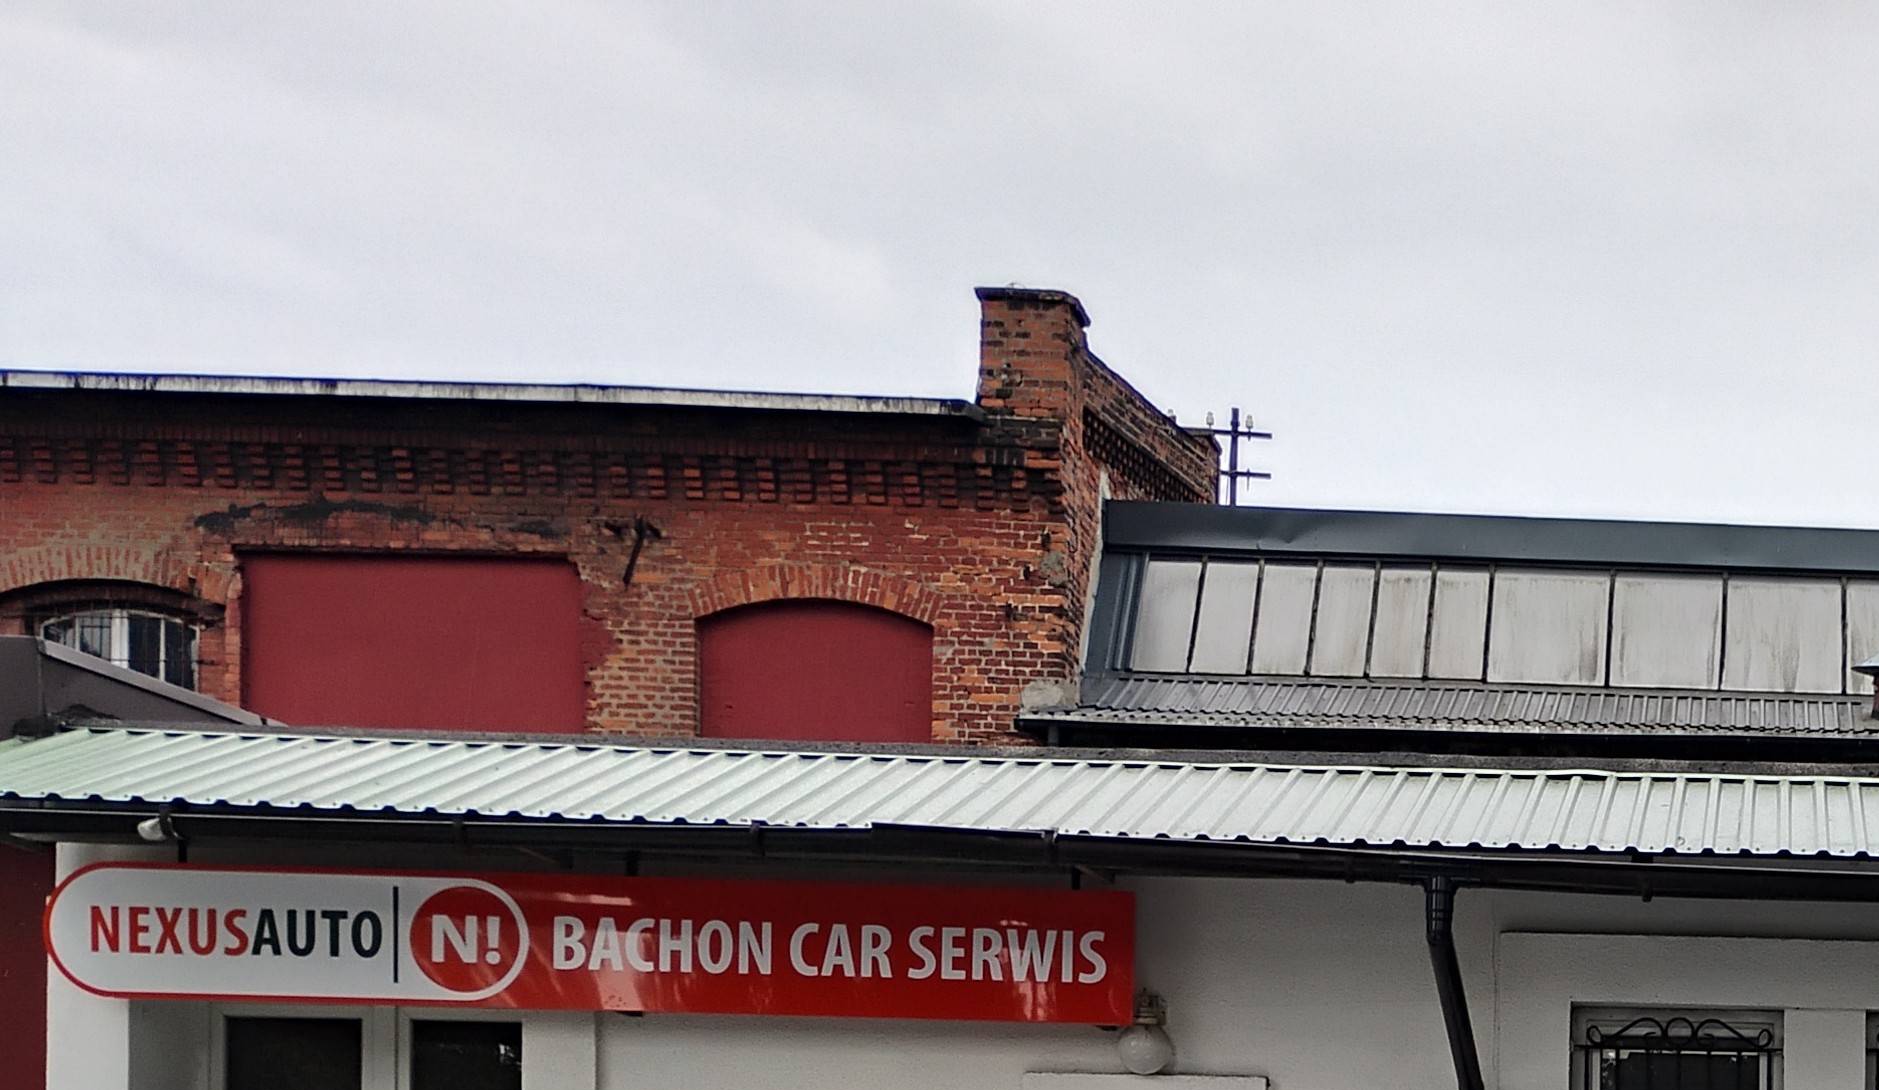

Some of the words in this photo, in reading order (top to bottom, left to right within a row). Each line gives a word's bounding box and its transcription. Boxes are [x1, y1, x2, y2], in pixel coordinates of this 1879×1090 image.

[90, 905, 382, 958] NEXUSAUTO
[431, 914, 501, 965] N!
[552, 916, 772, 975] BACHON
[789, 922, 893, 979] CAR
[907, 926, 1108, 984] SERWIS
